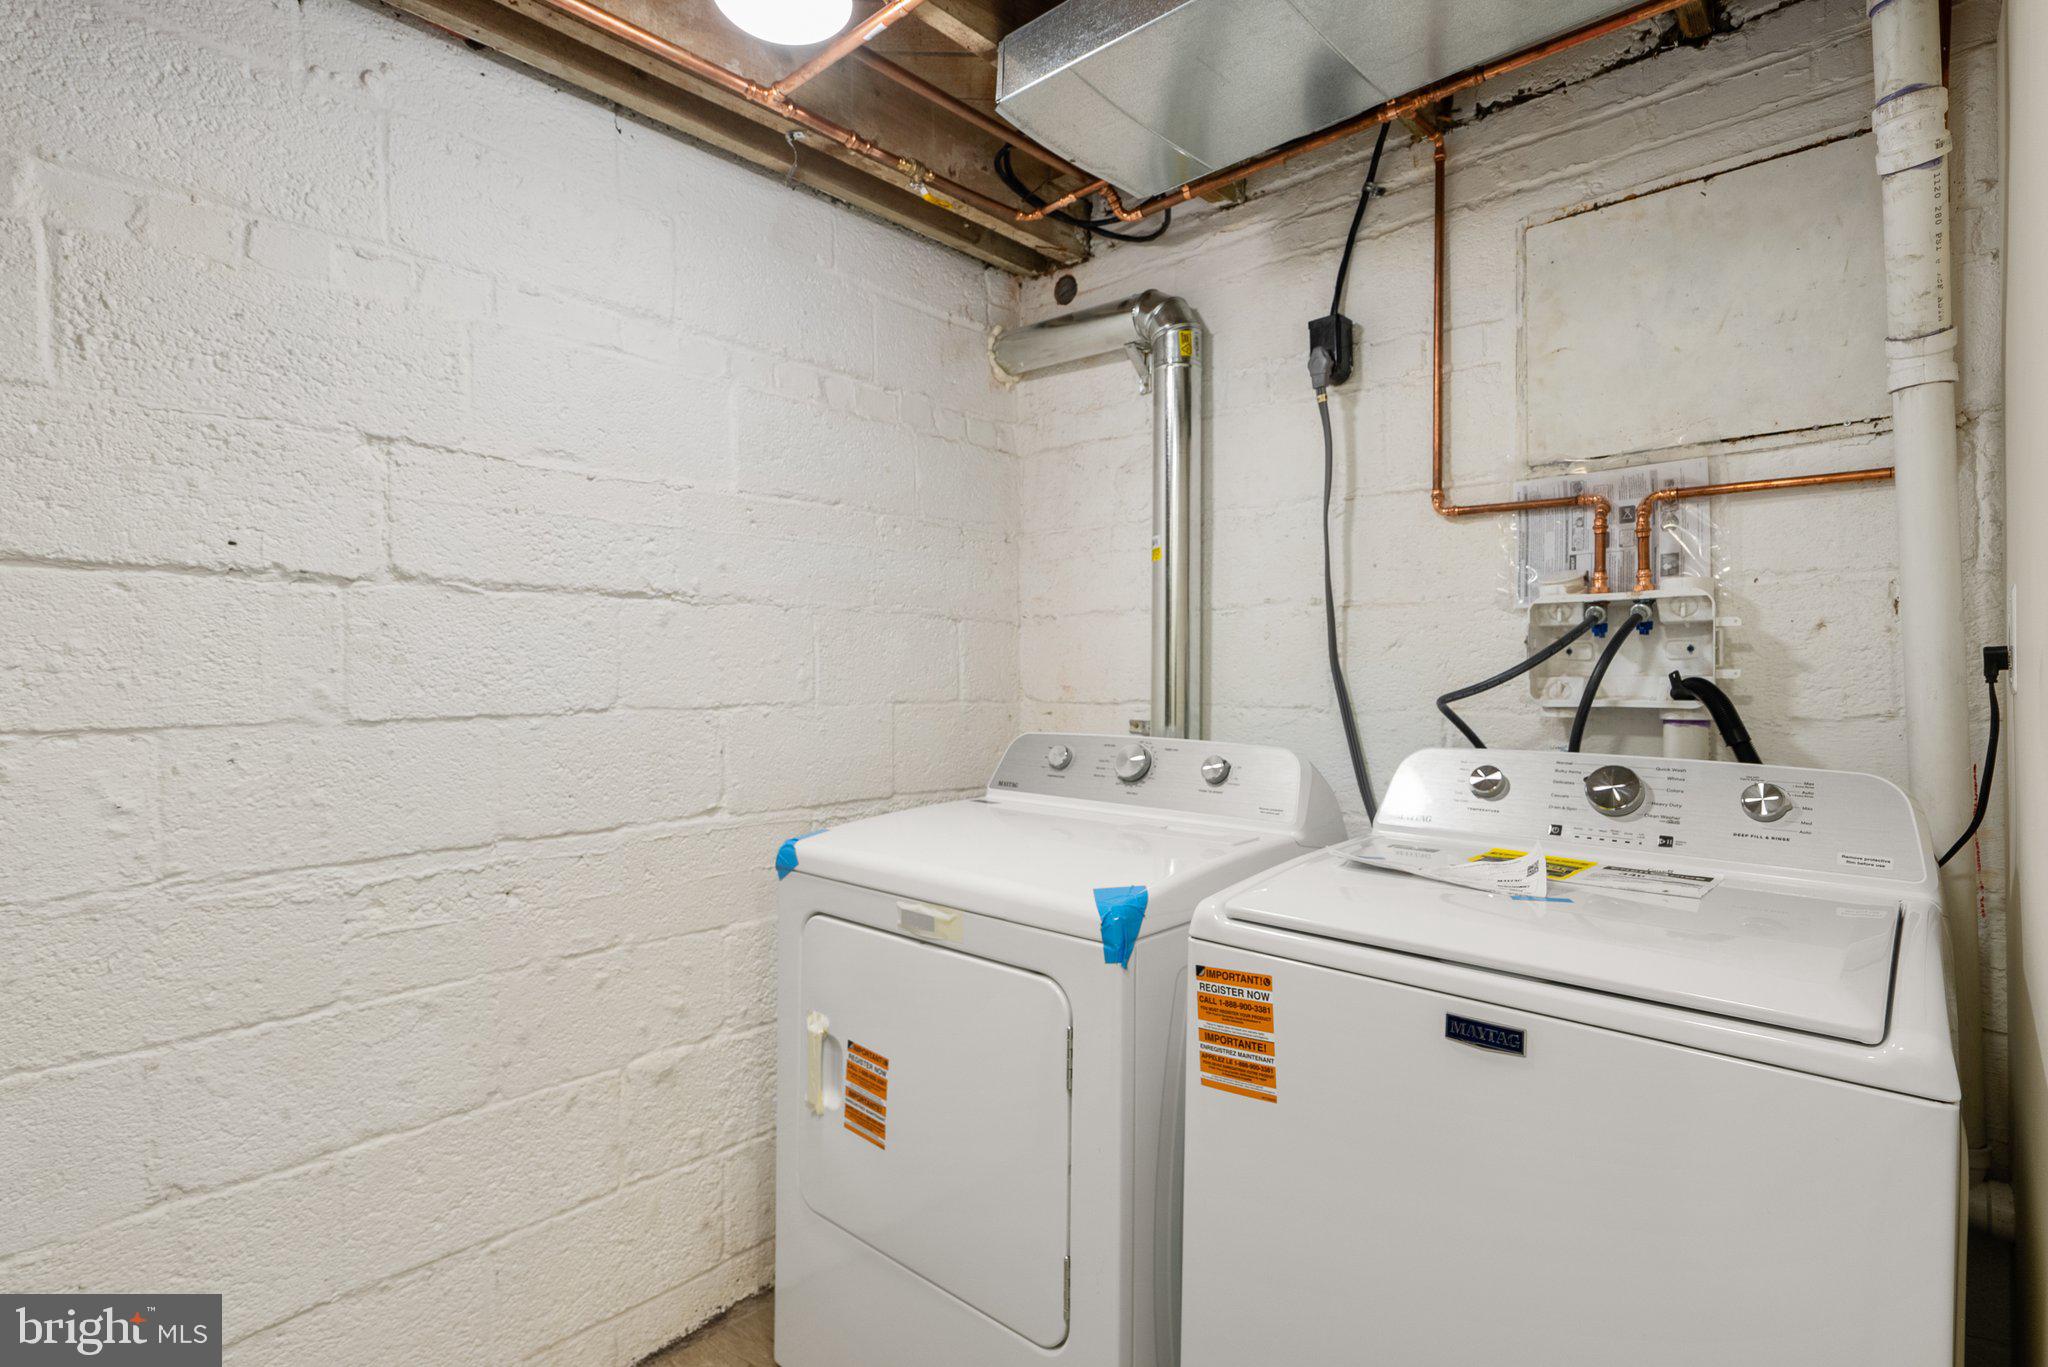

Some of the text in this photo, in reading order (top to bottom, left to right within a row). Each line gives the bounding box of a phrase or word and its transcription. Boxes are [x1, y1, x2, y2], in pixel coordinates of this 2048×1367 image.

[1934, 172, 1942, 198] 1120
[1934, 206, 1942, 225] 280
[1206, 969, 1263, 986] IMPORTANT!
[1200, 982, 1270, 1002] REGISTER NOW
[1199, 996, 1270, 1014] CALL 1-888-900-3381
[1204, 1032, 1266, 1052] IMPORTANTE!
[1450, 1020, 1520, 1048] MAYTAG
[1200, 1044, 1274, 1064] ENREGISTREZ MAINTENANT
[1201, 1054, 1225, 1064] APPELEZ
[874, 1065, 886, 1077] NOW
